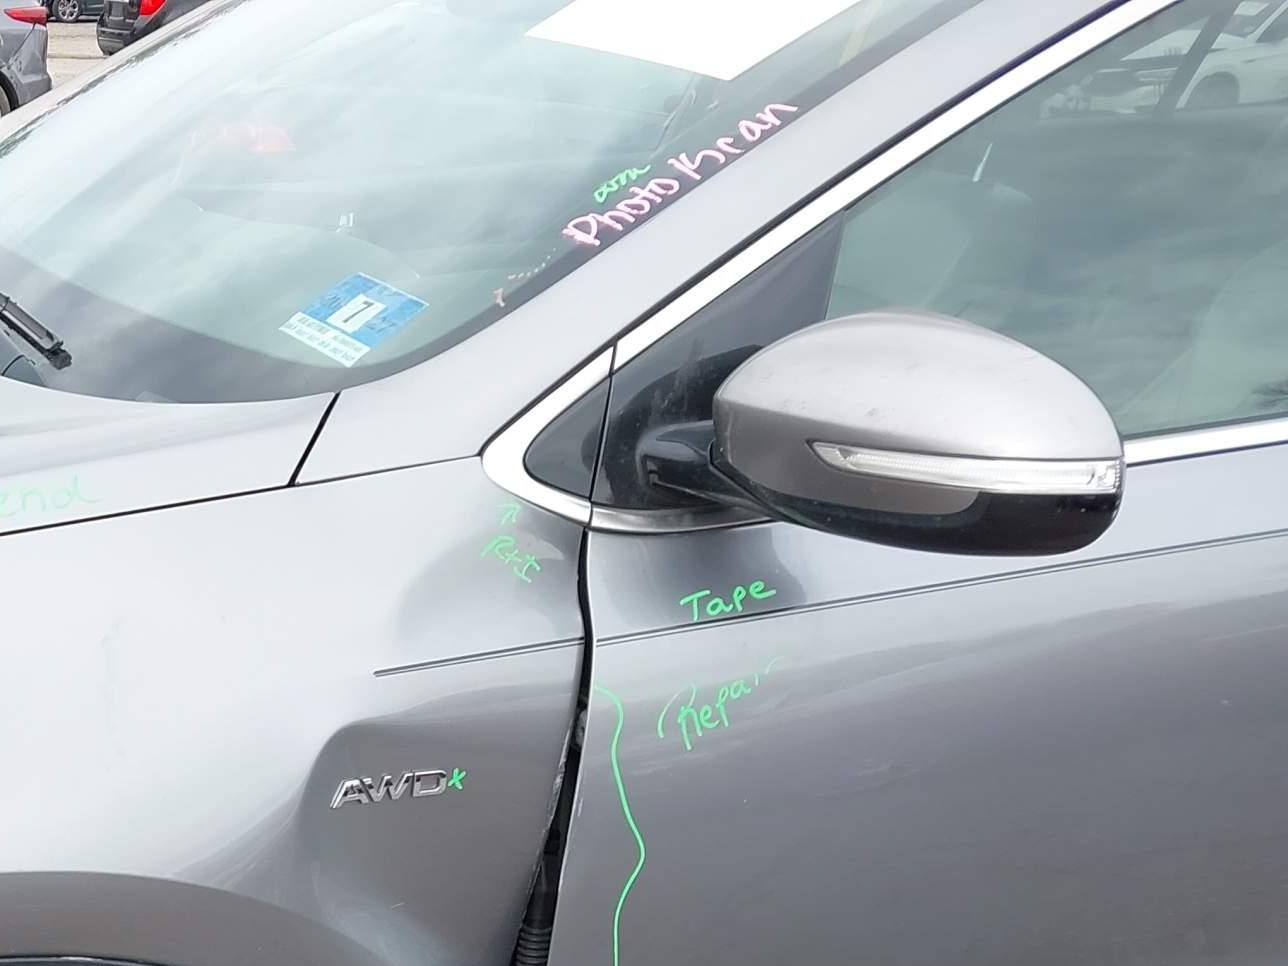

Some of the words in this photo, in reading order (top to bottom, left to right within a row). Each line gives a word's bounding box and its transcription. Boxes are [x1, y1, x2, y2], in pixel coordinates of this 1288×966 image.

[562, 176, 681, 246] Photo
[679, 580, 778, 622] Tape
[329, 769, 448, 809] AWD
